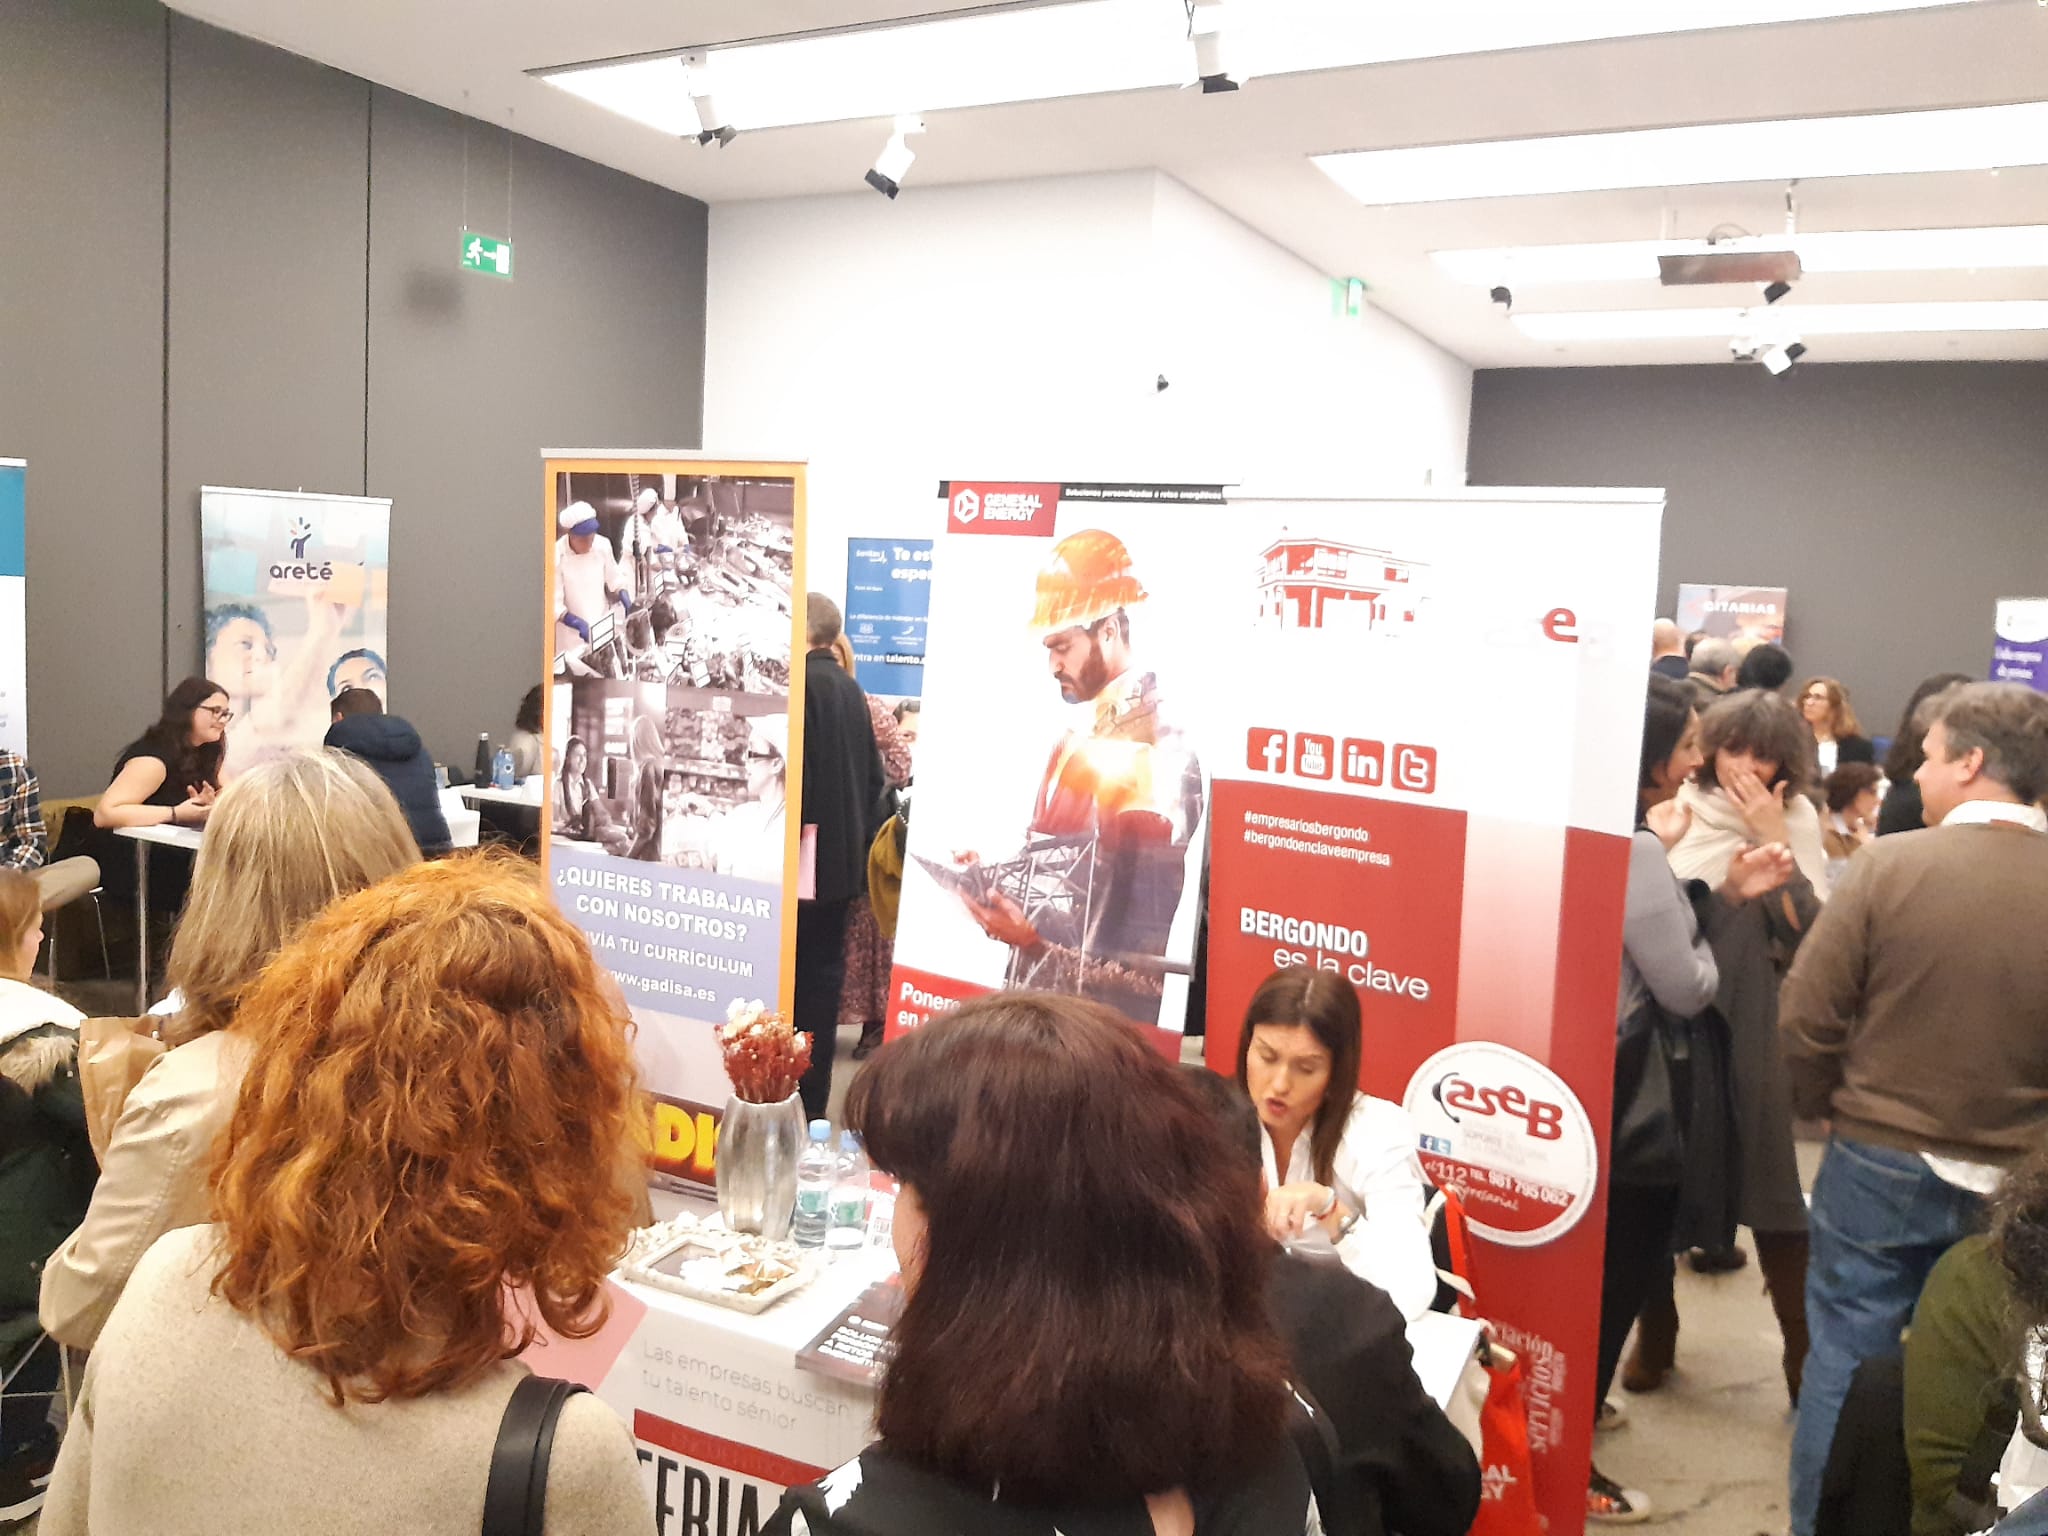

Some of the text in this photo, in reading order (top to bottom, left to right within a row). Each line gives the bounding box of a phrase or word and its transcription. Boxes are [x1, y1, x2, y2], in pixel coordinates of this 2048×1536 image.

[269, 561, 333, 580] areté
[854, 653, 872, 663] ntra
[1304, 737, 1323, 756] You
[1347, 744, 1378, 780] in
[1243, 810, 1369, 842] #empresariosbergondo
[1243, 829, 1391, 867] #bergondoenclaveempresa
[556, 866, 772, 919] ¿QUIERES TRABAJAR
[576, 894, 749, 942] CON NOSOTROS?
[1240, 907, 1368, 958] BERGONDO
[587, 930, 754, 978] VÍA TU CURRÍCULUM
[1273, 948, 1430, 999] es la clave
[897, 1010, 919, 1027] en
[642, 1369, 798, 1430] tu talento sénior
[643, 1339, 850, 1416] Las empresas buscan
[637, 1448, 762, 1536] ERIA
